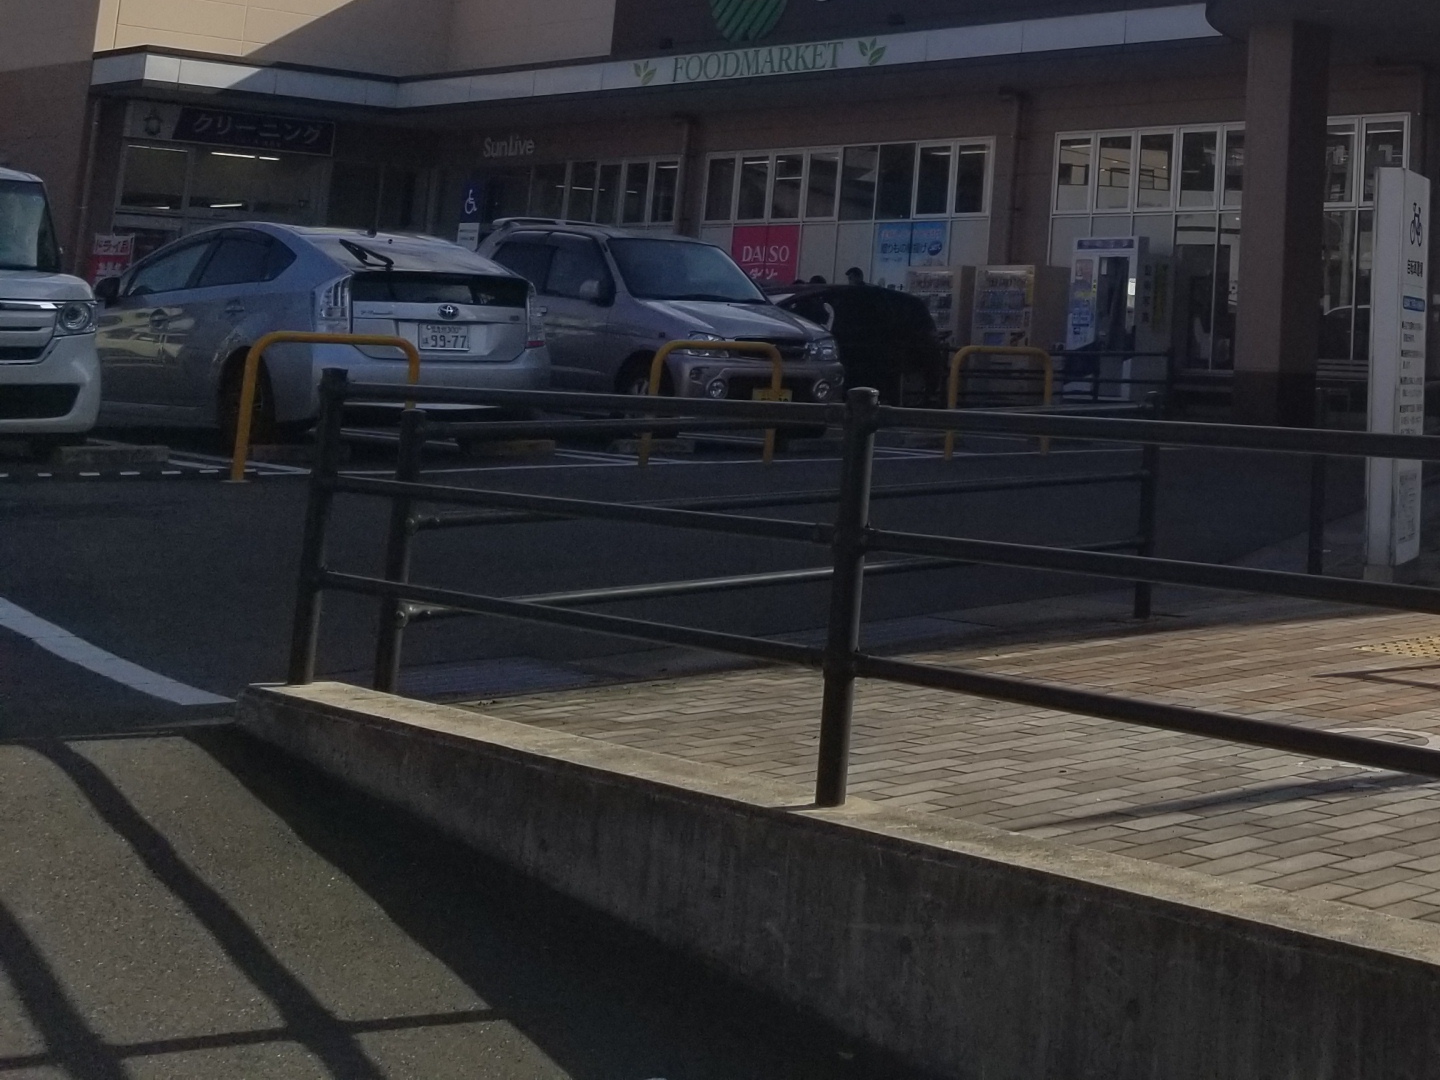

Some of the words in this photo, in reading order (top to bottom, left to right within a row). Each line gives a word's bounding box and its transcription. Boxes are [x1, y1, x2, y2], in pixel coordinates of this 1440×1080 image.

[672, 41, 844, 83] FOODMARKET
[193, 112, 323, 144] クリーニング
[483, 133, 536, 158] SunLive
[742, 245, 790, 262] DAISO
[430, 334, 467, 348] 99-77
